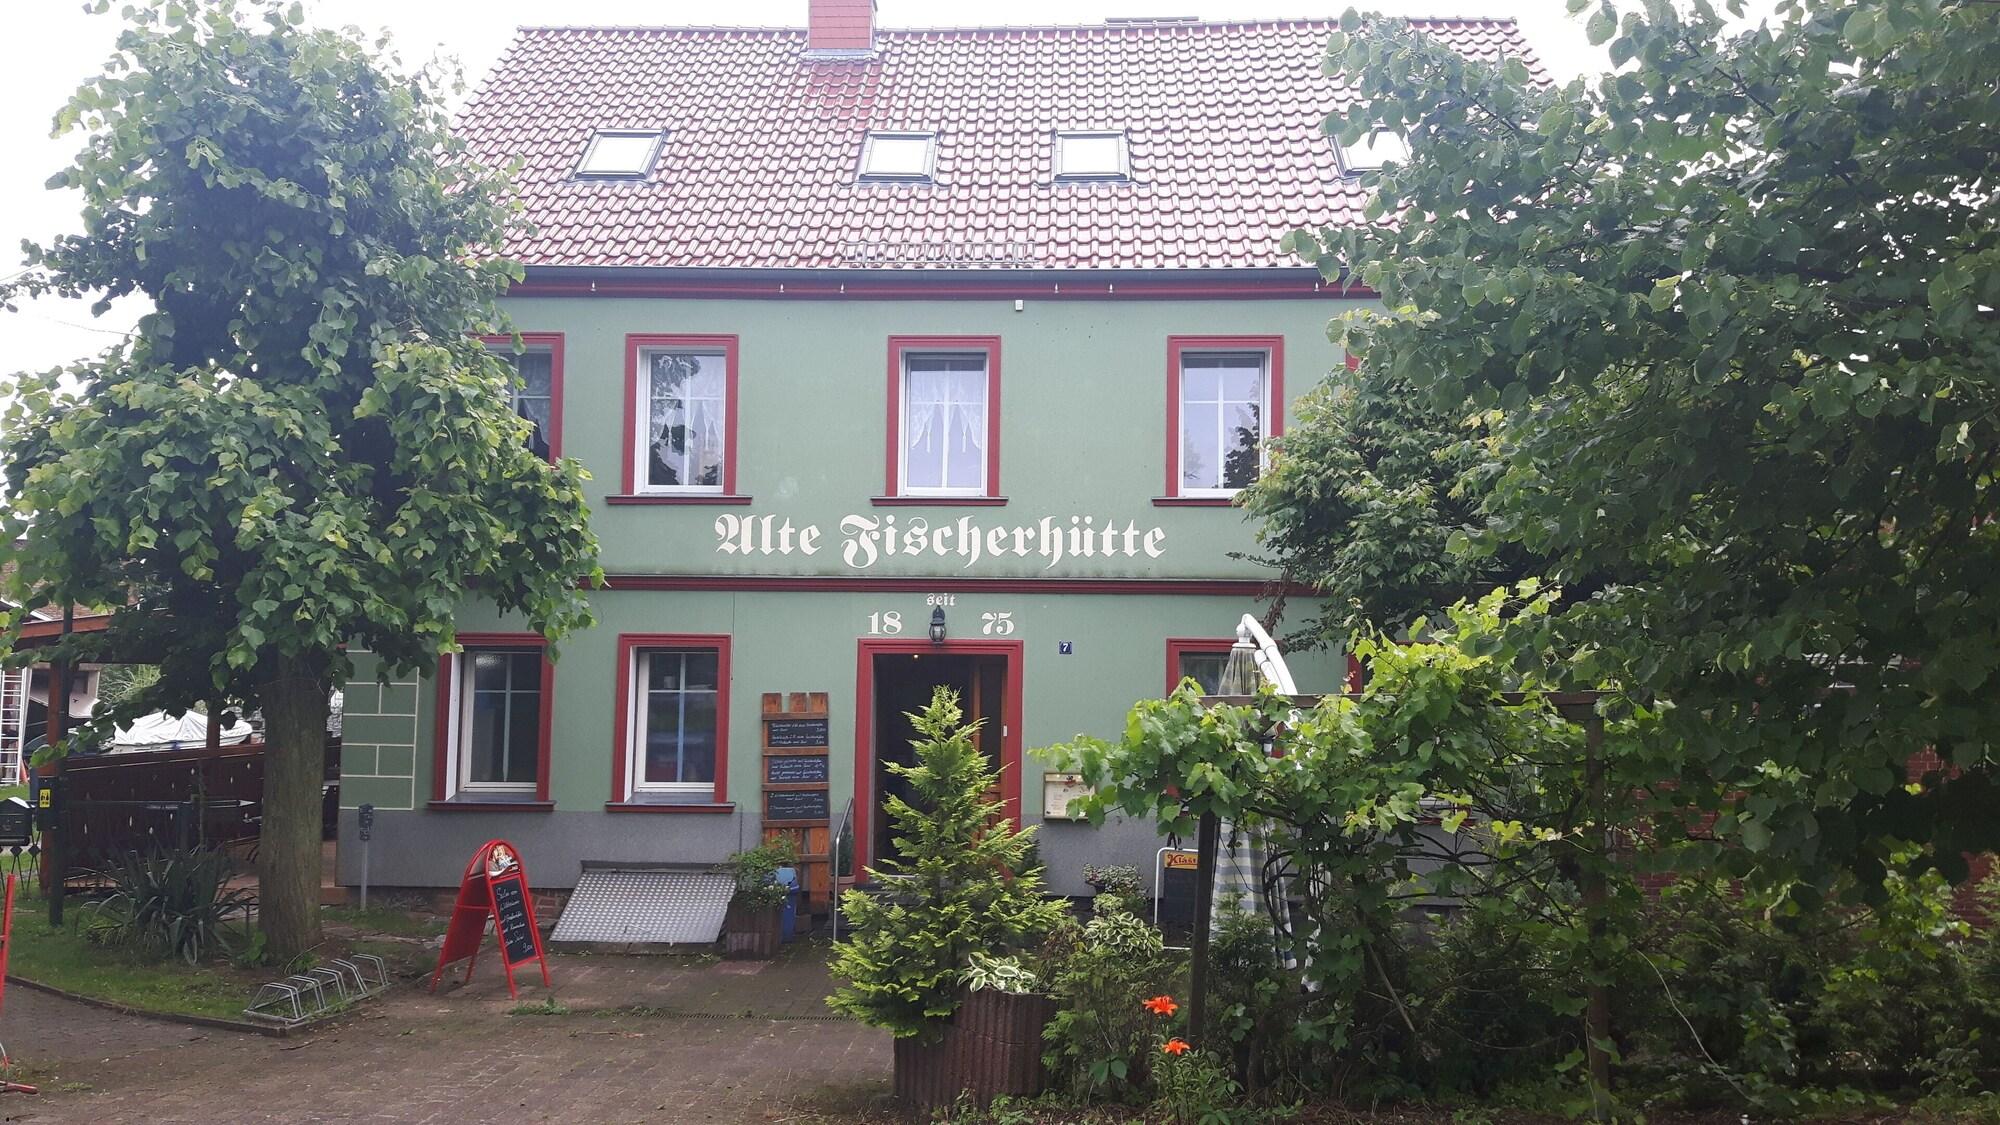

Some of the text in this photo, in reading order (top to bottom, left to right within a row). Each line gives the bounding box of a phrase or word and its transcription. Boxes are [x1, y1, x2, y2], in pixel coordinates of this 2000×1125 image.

[714, 514, 1167, 569] Alte Fischerhütte
[926, 593, 956, 606] seit
[867, 611, 1015, 636] 18 75
